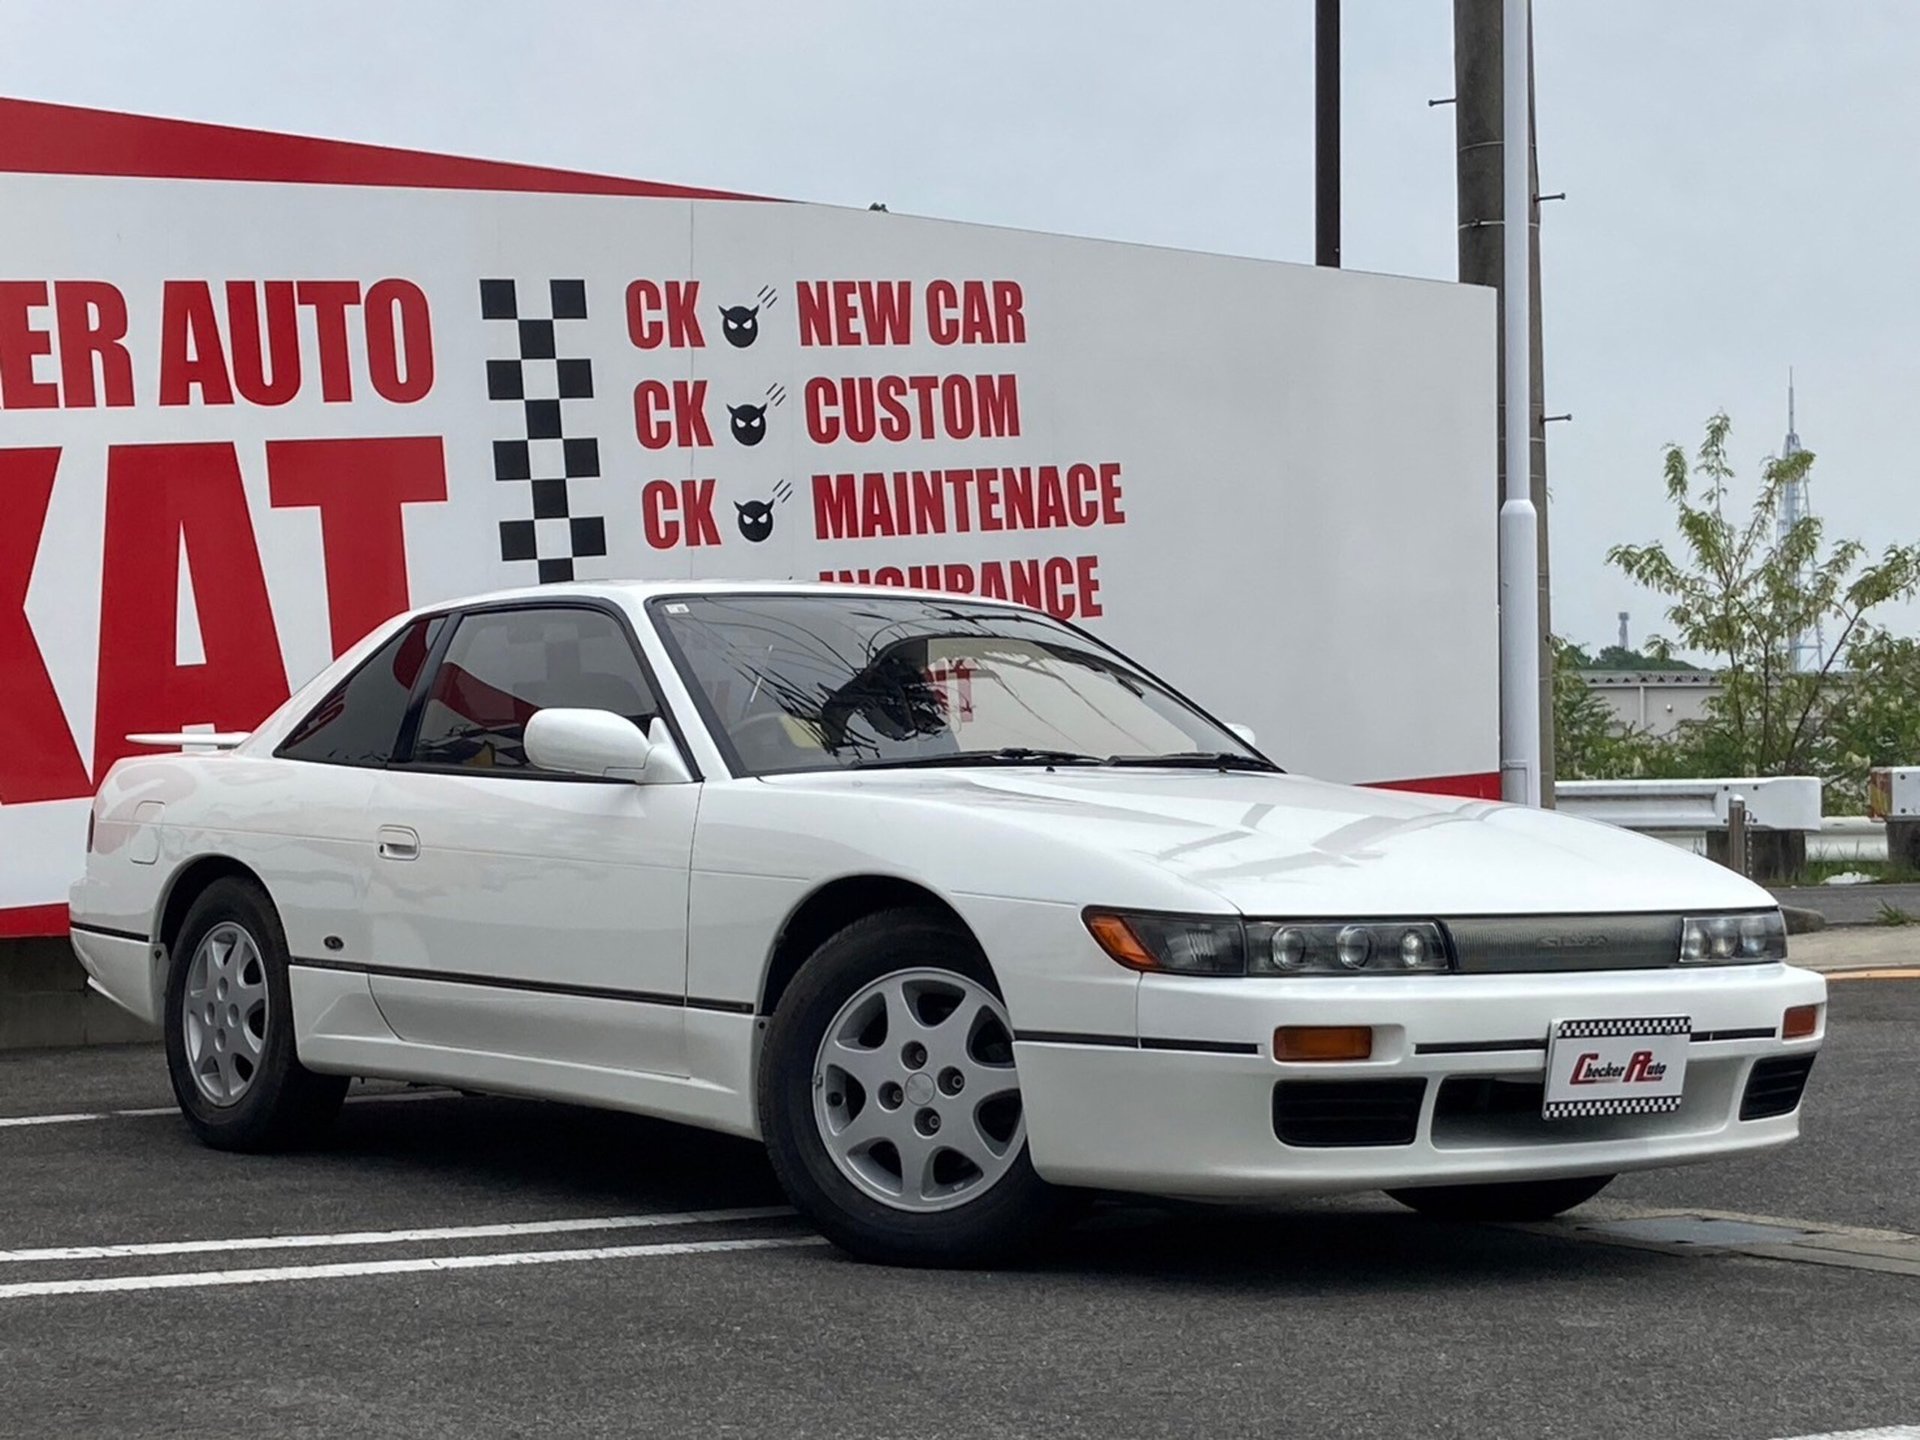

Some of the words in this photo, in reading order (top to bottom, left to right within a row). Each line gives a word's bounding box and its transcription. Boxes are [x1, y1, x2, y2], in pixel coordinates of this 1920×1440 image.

[159, 278, 436, 407] AUTO
[627, 280, 705, 349] CK
[797, 281, 912, 346] NEW
[926, 280, 1027, 345] CAR
[634, 380, 714, 450] CK
[804, 374, 1021, 445] CUSTOM
[642, 479, 721, 549] CK
[812, 463, 1126, 540] MAINTENACE
